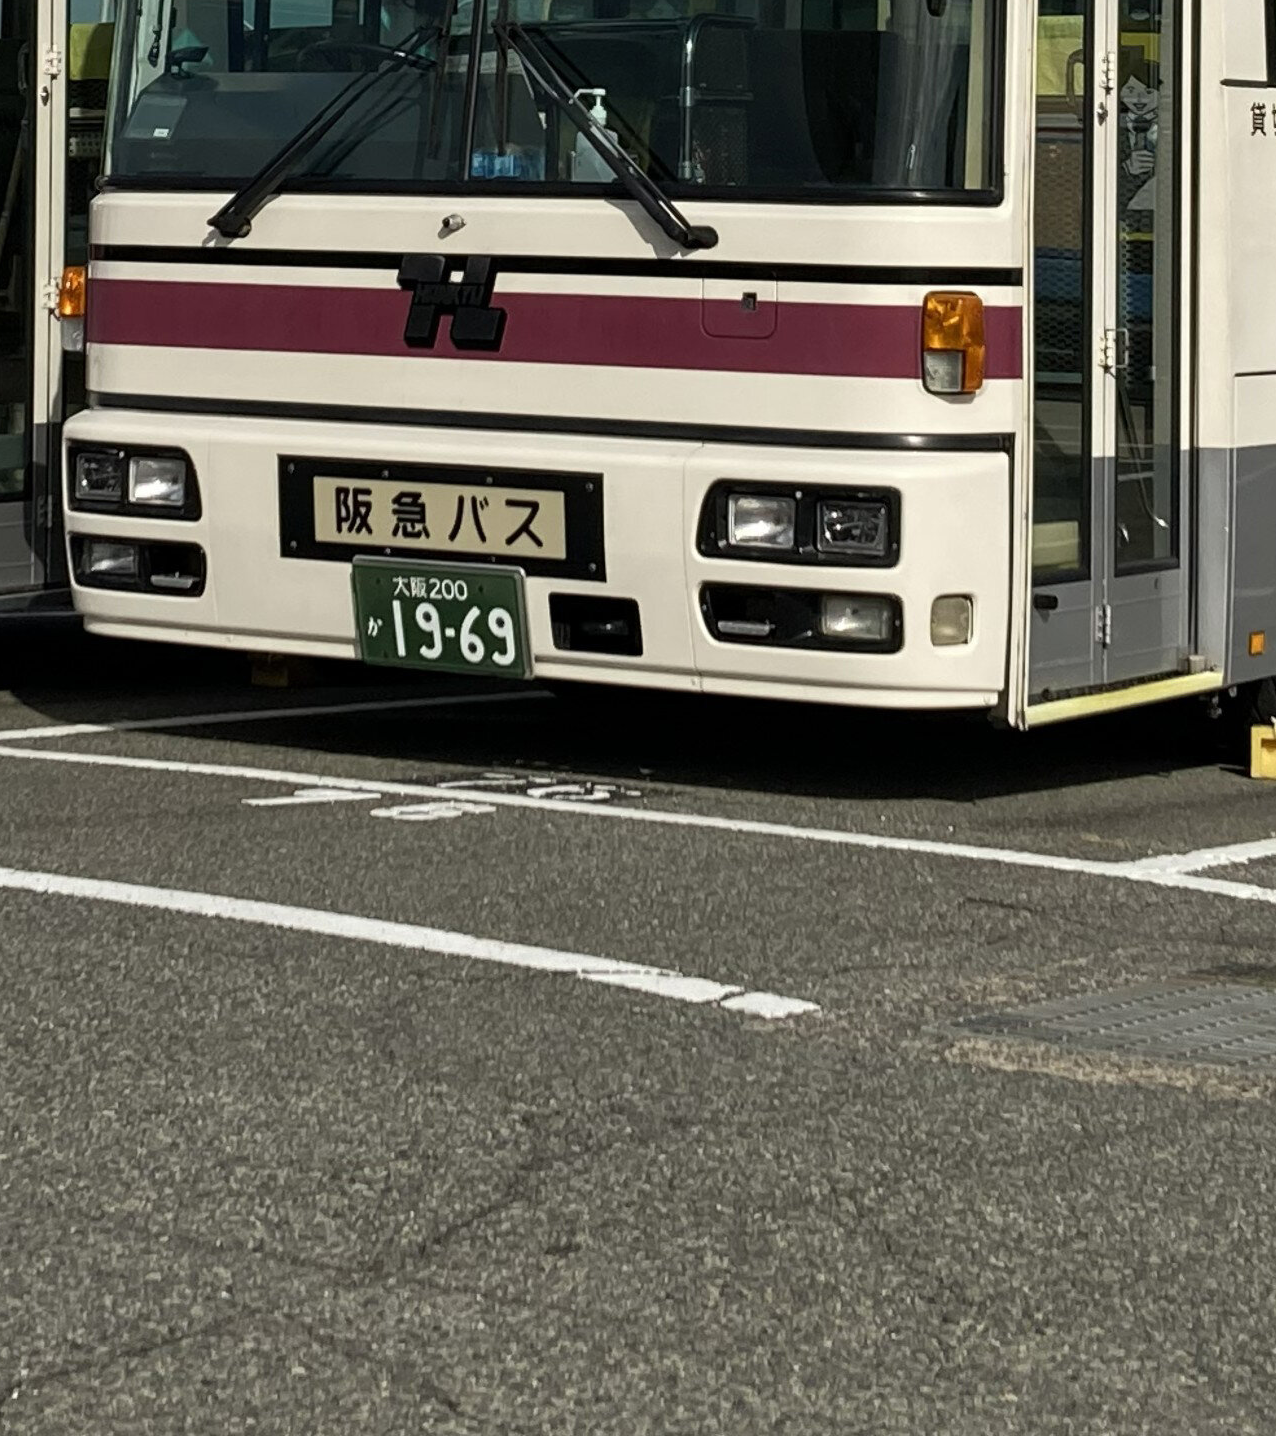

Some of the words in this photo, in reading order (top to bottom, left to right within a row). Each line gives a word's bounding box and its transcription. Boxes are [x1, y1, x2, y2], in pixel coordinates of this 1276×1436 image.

[334, 485, 544, 549] 阪急バス
[391, 576, 469, 601] 大阪200
[391, 598, 516, 666] 19-69
